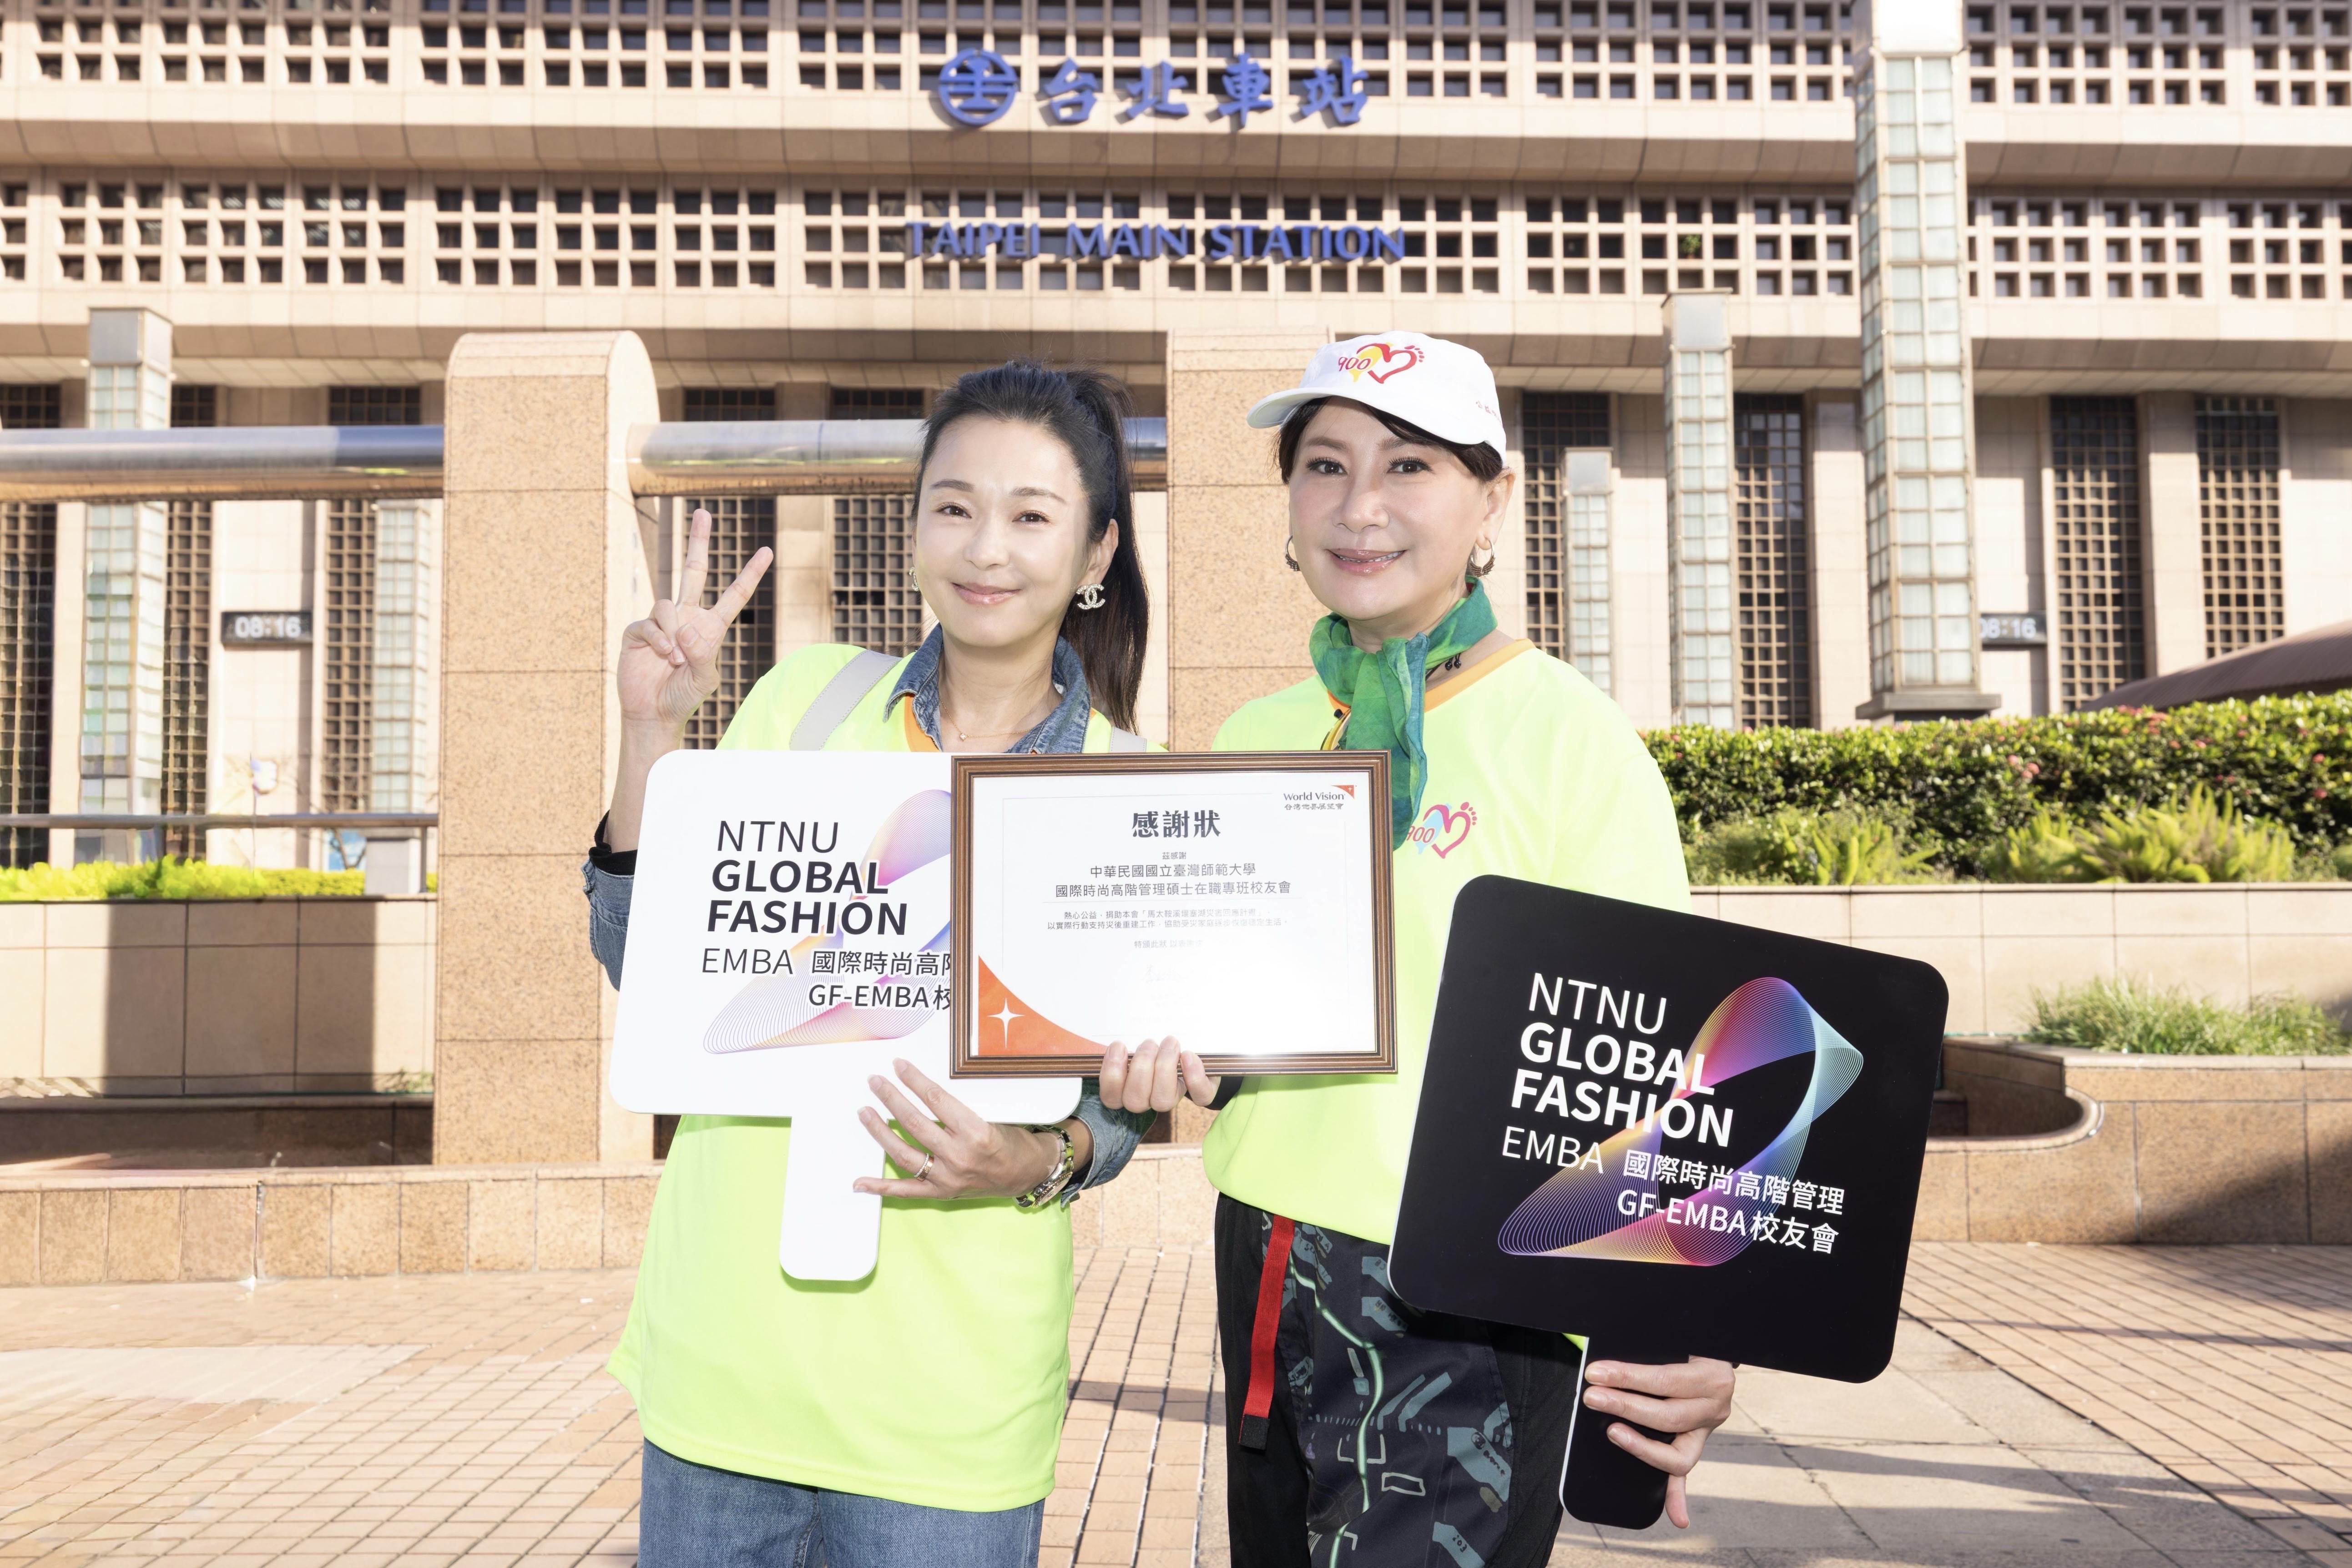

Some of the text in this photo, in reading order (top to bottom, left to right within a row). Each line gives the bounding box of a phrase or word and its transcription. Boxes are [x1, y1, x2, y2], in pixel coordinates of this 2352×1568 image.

[1044, 53, 1368, 126] 台北車站
[906, 222, 1405, 261] TAIPEI MAIN STATION
[1338, 356, 1371, 372] 900
[234, 616, 301, 638] 08:16
[1283, 792, 1344, 801] World Vision
[717, 821, 839, 853] NTNU
[1131, 810, 1221, 838] 感謝狀
[1090, 863, 1256, 878] 中華民國國立臺灣師範大學
[1162, 851, 1186, 860] 茲感謝
[712, 860, 888, 894] GLOBAL
[1055, 881, 1291, 898] 國際時尚高階管理碩士在職專班校友會
[707, 900, 907, 936] FASHION
[702, 948, 793, 975] EMBA
[1529, 973, 1667, 1034] NTNU
[1520, 1022, 1715, 1095] GLOBAL
[1511, 1069, 1733, 1147] FASHION
[1503, 1126, 1845, 1215] EMBA 國際時尚高階管理
